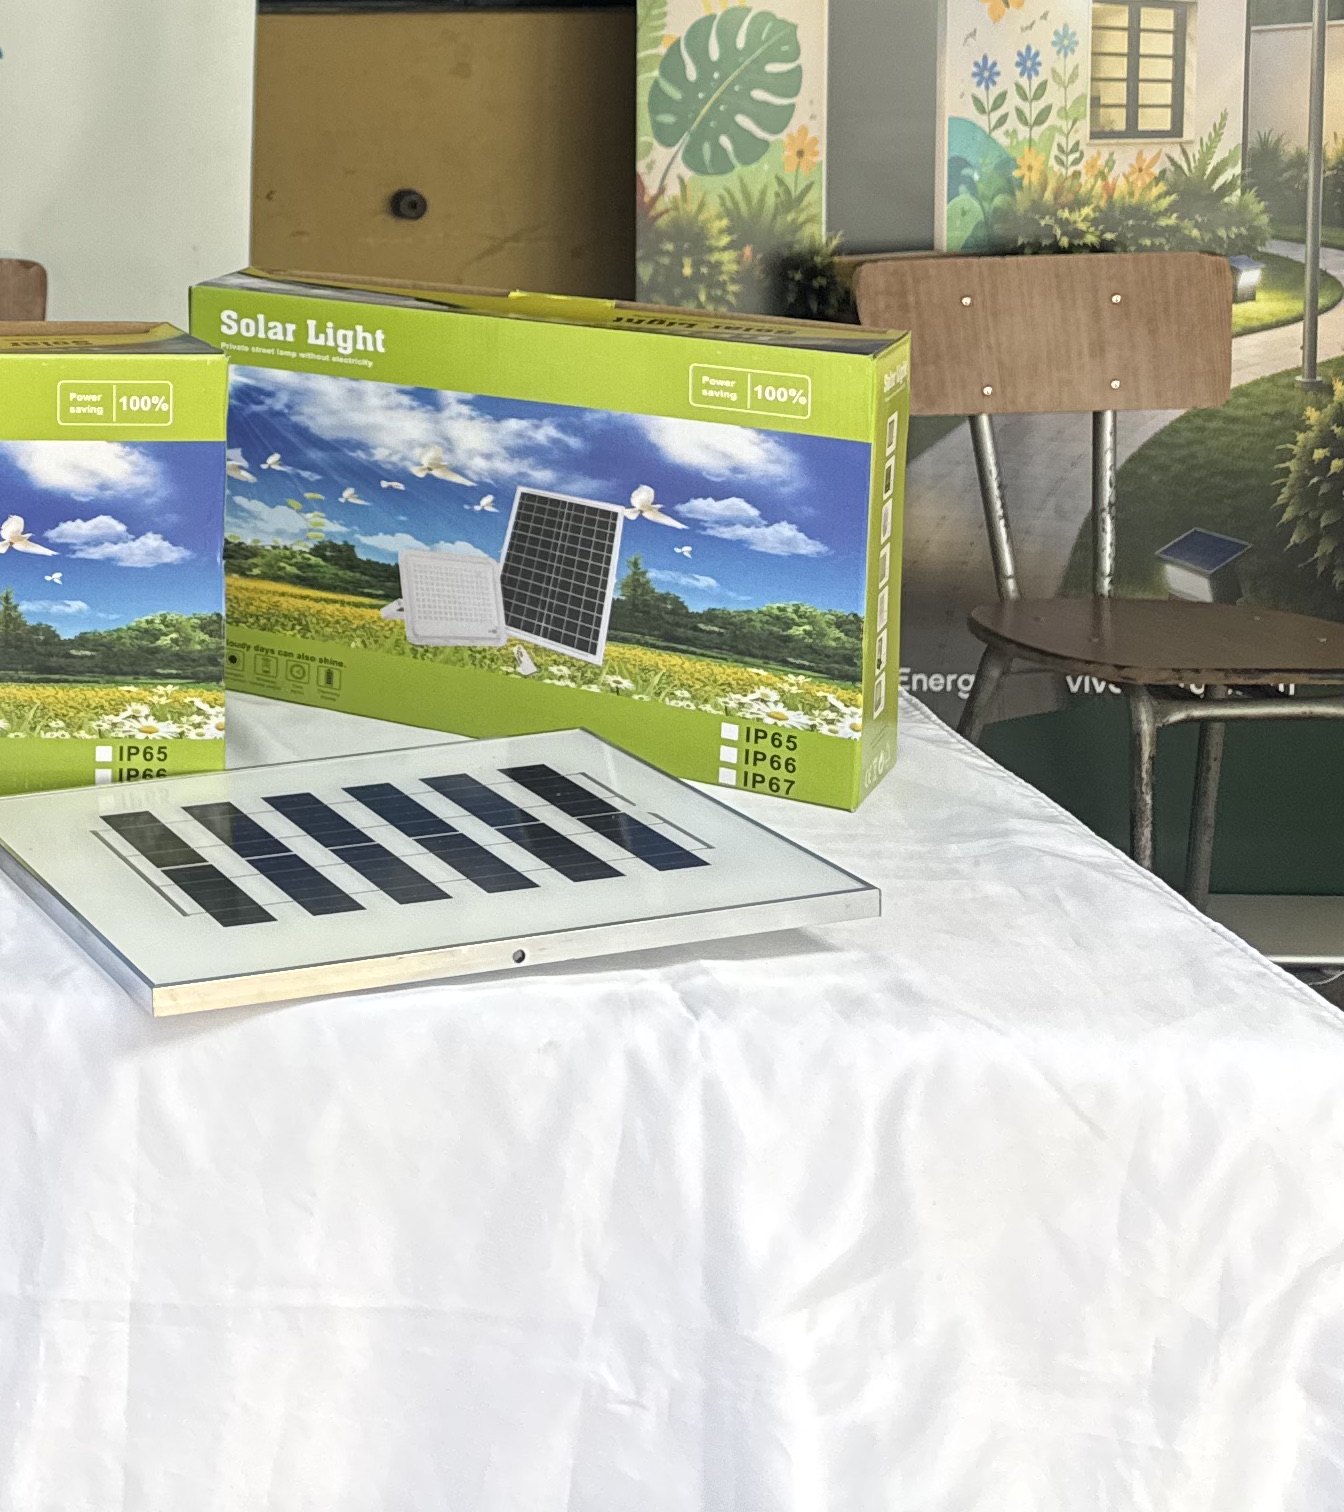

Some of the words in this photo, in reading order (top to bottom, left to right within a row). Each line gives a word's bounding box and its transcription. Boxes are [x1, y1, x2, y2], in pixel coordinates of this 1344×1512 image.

[220, 309, 297, 343] Solar
[306, 319, 386, 355] Light
[220, 341, 250, 353] Private
[251, 345, 275, 356] street
[276, 348, 298, 359] lamp
[298, 351, 331, 362] without
[331, 354, 374, 369] electricity
[701, 375, 737, 388] Power
[69, 392, 103, 402] Power
[119, 395, 170, 412] 100%
[701, 388, 738, 402] saving
[753, 384, 808, 406] 100%
[69, 404, 104, 416] saving
[227, 639, 251, 652] loudy
[254, 644, 275, 655] days
[278, 649, 294, 658] can
[296, 652, 316, 663] also
[898, 667, 976, 700] Energ
[745, 726, 798, 752] IP65
[118, 745, 168, 762] IP65
[744, 748, 797, 774] IP66
[743, 770, 796, 796] IP67
